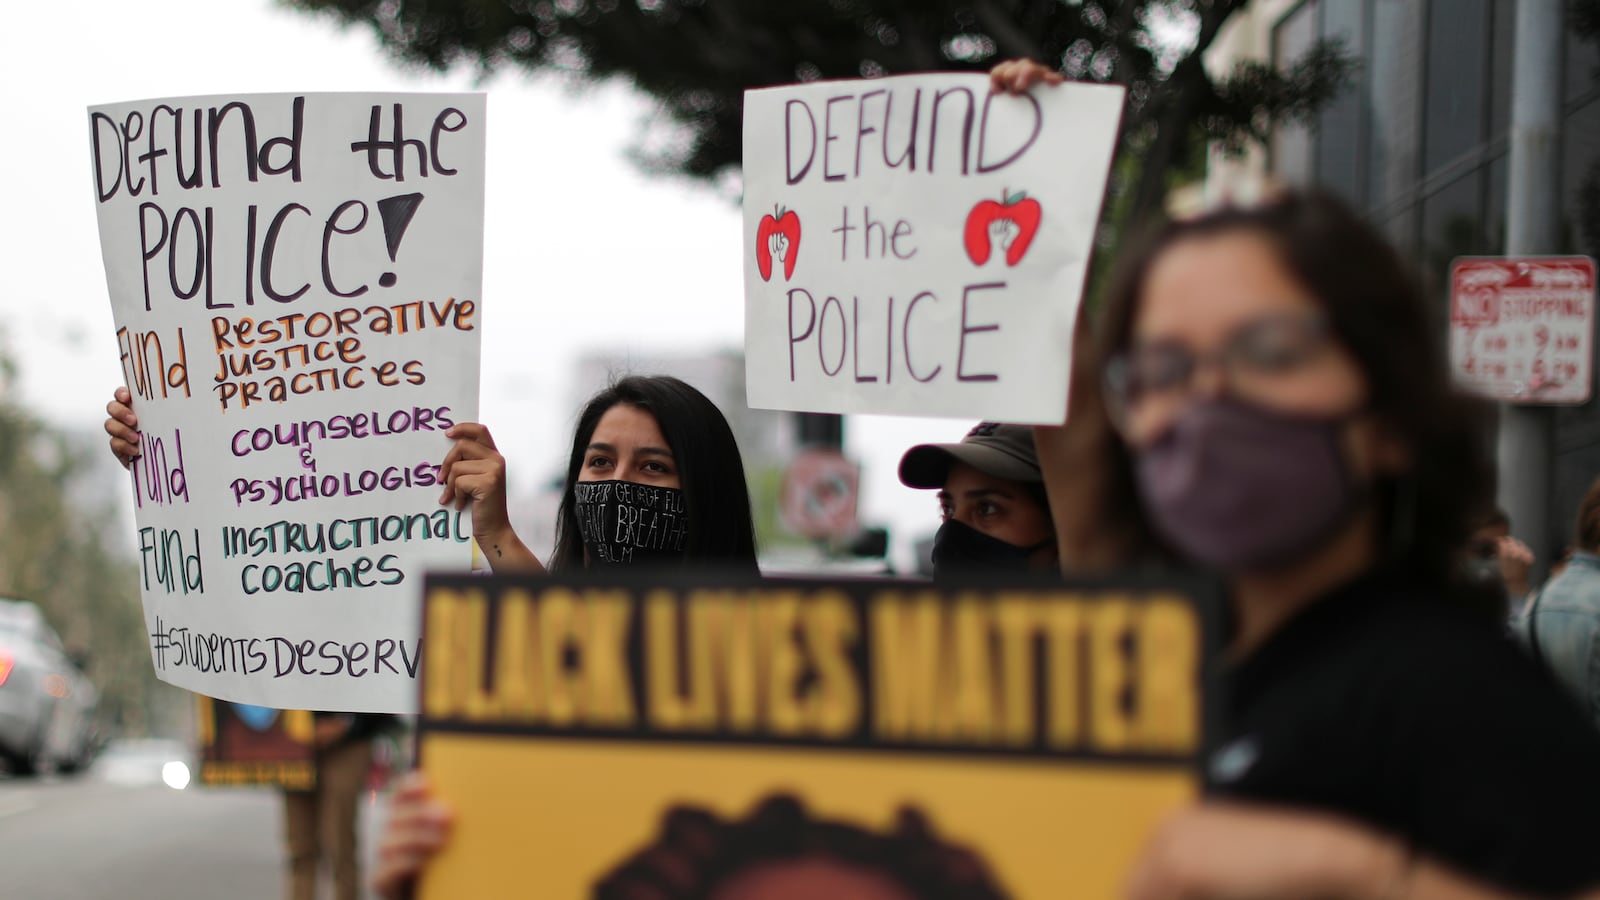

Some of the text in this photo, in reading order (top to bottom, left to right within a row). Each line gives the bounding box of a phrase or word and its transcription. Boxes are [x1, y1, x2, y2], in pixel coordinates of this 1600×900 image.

[351, 103, 468, 182] the
[832, 205, 918, 262] the
[786, 282, 1008, 385] POLICE
[300, 446, 316, 472] &
[139, 527, 204, 596] Fund
[422, 586, 1200, 755] BLACK LIVES MATTER
